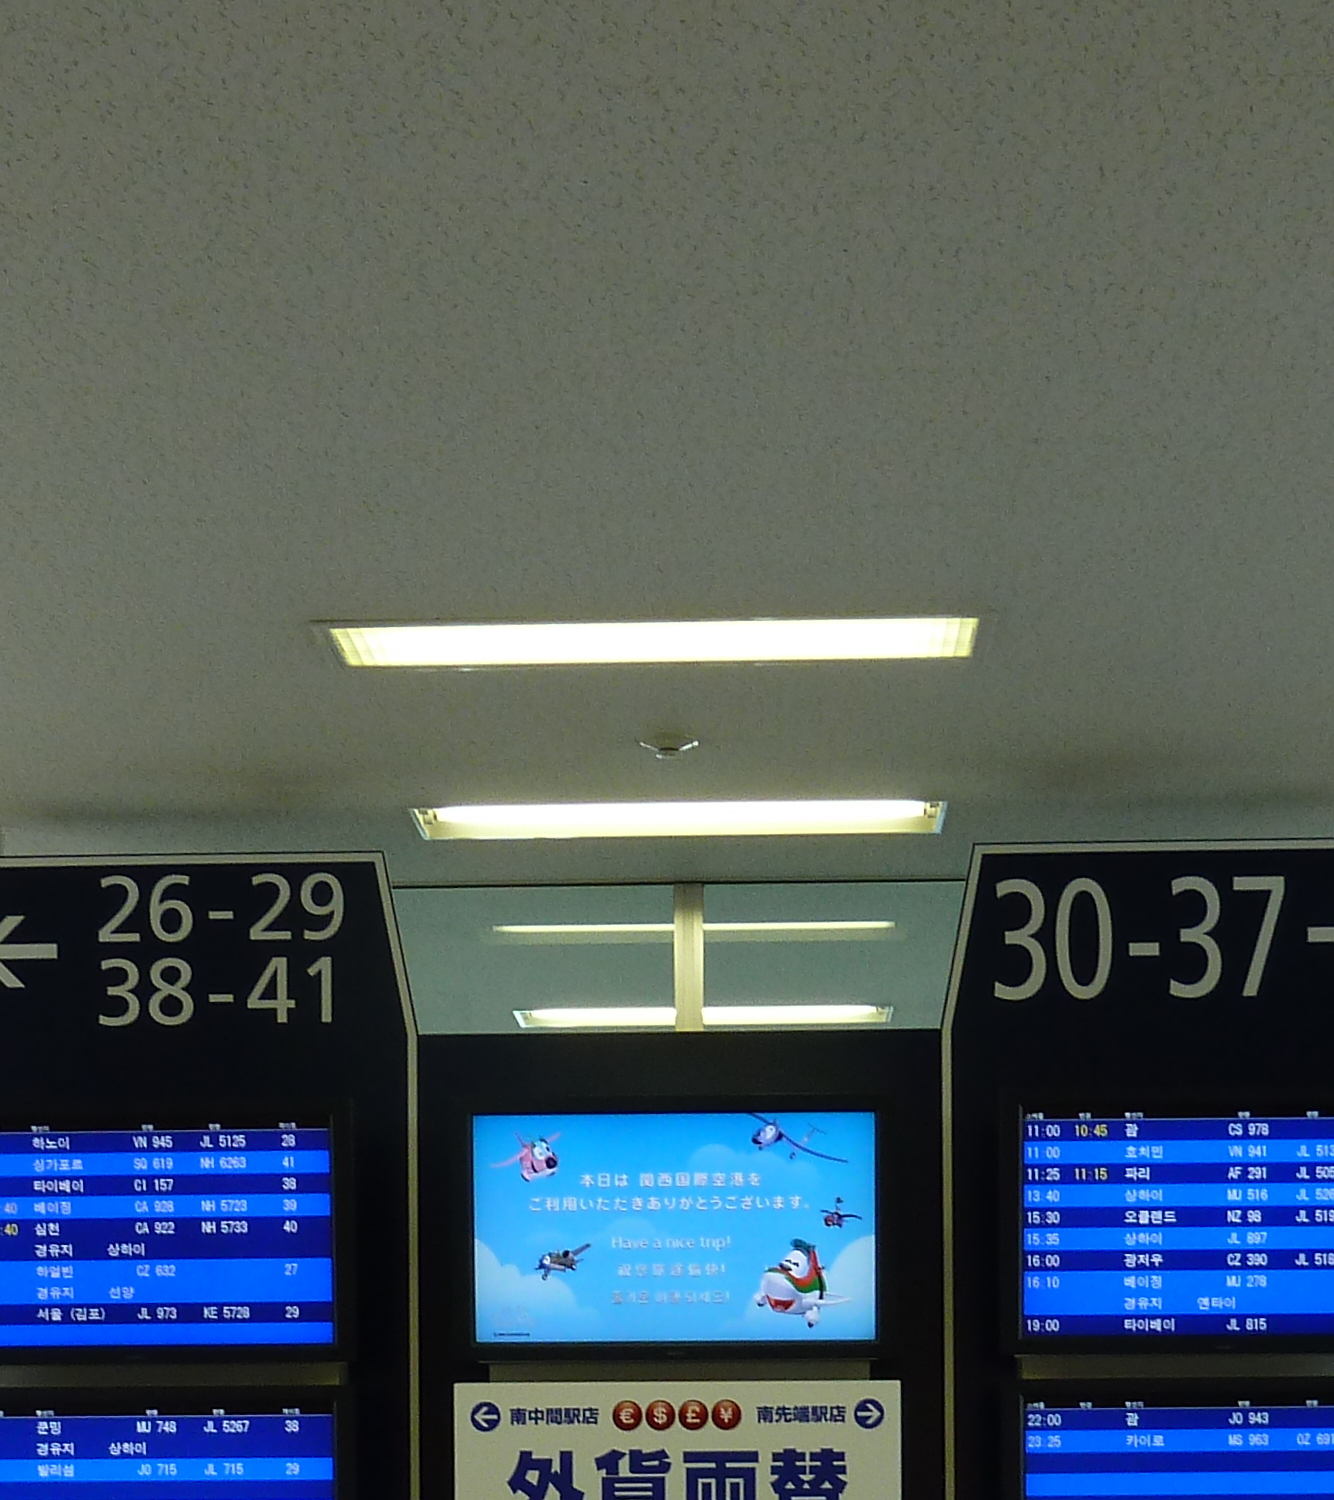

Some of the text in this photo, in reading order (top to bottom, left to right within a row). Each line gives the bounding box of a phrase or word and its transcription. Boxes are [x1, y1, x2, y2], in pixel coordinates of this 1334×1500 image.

[992, 875, 1288, 1002] 30-37
[1028, 1125, 1060, 1137] 11:00
[1076, 1124, 1107, 1136] 10:45
[1126, 1124, 1138, 1137] 괌
[1229, 1123, 1242, 1135] CS
[1248, 1123, 1269, 1135] 978
[33, 1137, 69, 1149] 하노이
[133, 1136, 147, 1148] VN
[152, 1136, 172, 1148] 945
[200, 1136, 213, 1147] JL
[219, 1135, 246, 1147] 5125
[1028, 1168, 1060, 1180] 11:25
[1075, 1168, 1107, 1180] 11:15
[1126, 1167, 1149, 1180] 파리
[1228, 1167, 1241, 1179] AF
[1248, 1167, 1266, 1179] 291
[1296, 1167, 1310, 1179] JL
[35, 1223, 59, 1236] 심천
[135, 1222, 149, 1234] CA
[154, 1222, 174, 1234] 922
[202, 1222, 216, 1233] NH
[221, 1221, 247, 1233] 5733
[284, 1221, 297, 1232] 40
[611, 1236, 648, 1249] Have
[653, 1239, 662, 1249] a
[666, 1236, 695, 1249] nice
[509, 1407, 599, 1426] 南中間駅店
[756, 1405, 847, 1424] 南先端駅店
[1028, 1414, 1061, 1426] 22:00
[1126, 1413, 1138, 1426] 괌
[1229, 1412, 1243, 1424] JO
[1249, 1412, 1268, 1424] 943
[137, 1421, 151, 1432] MU
[157, 1421, 176, 1432] 748
[204, 1421, 217, 1432] JL
[223, 1420, 249, 1432] 5267
[285, 1420, 299, 1432] 38
